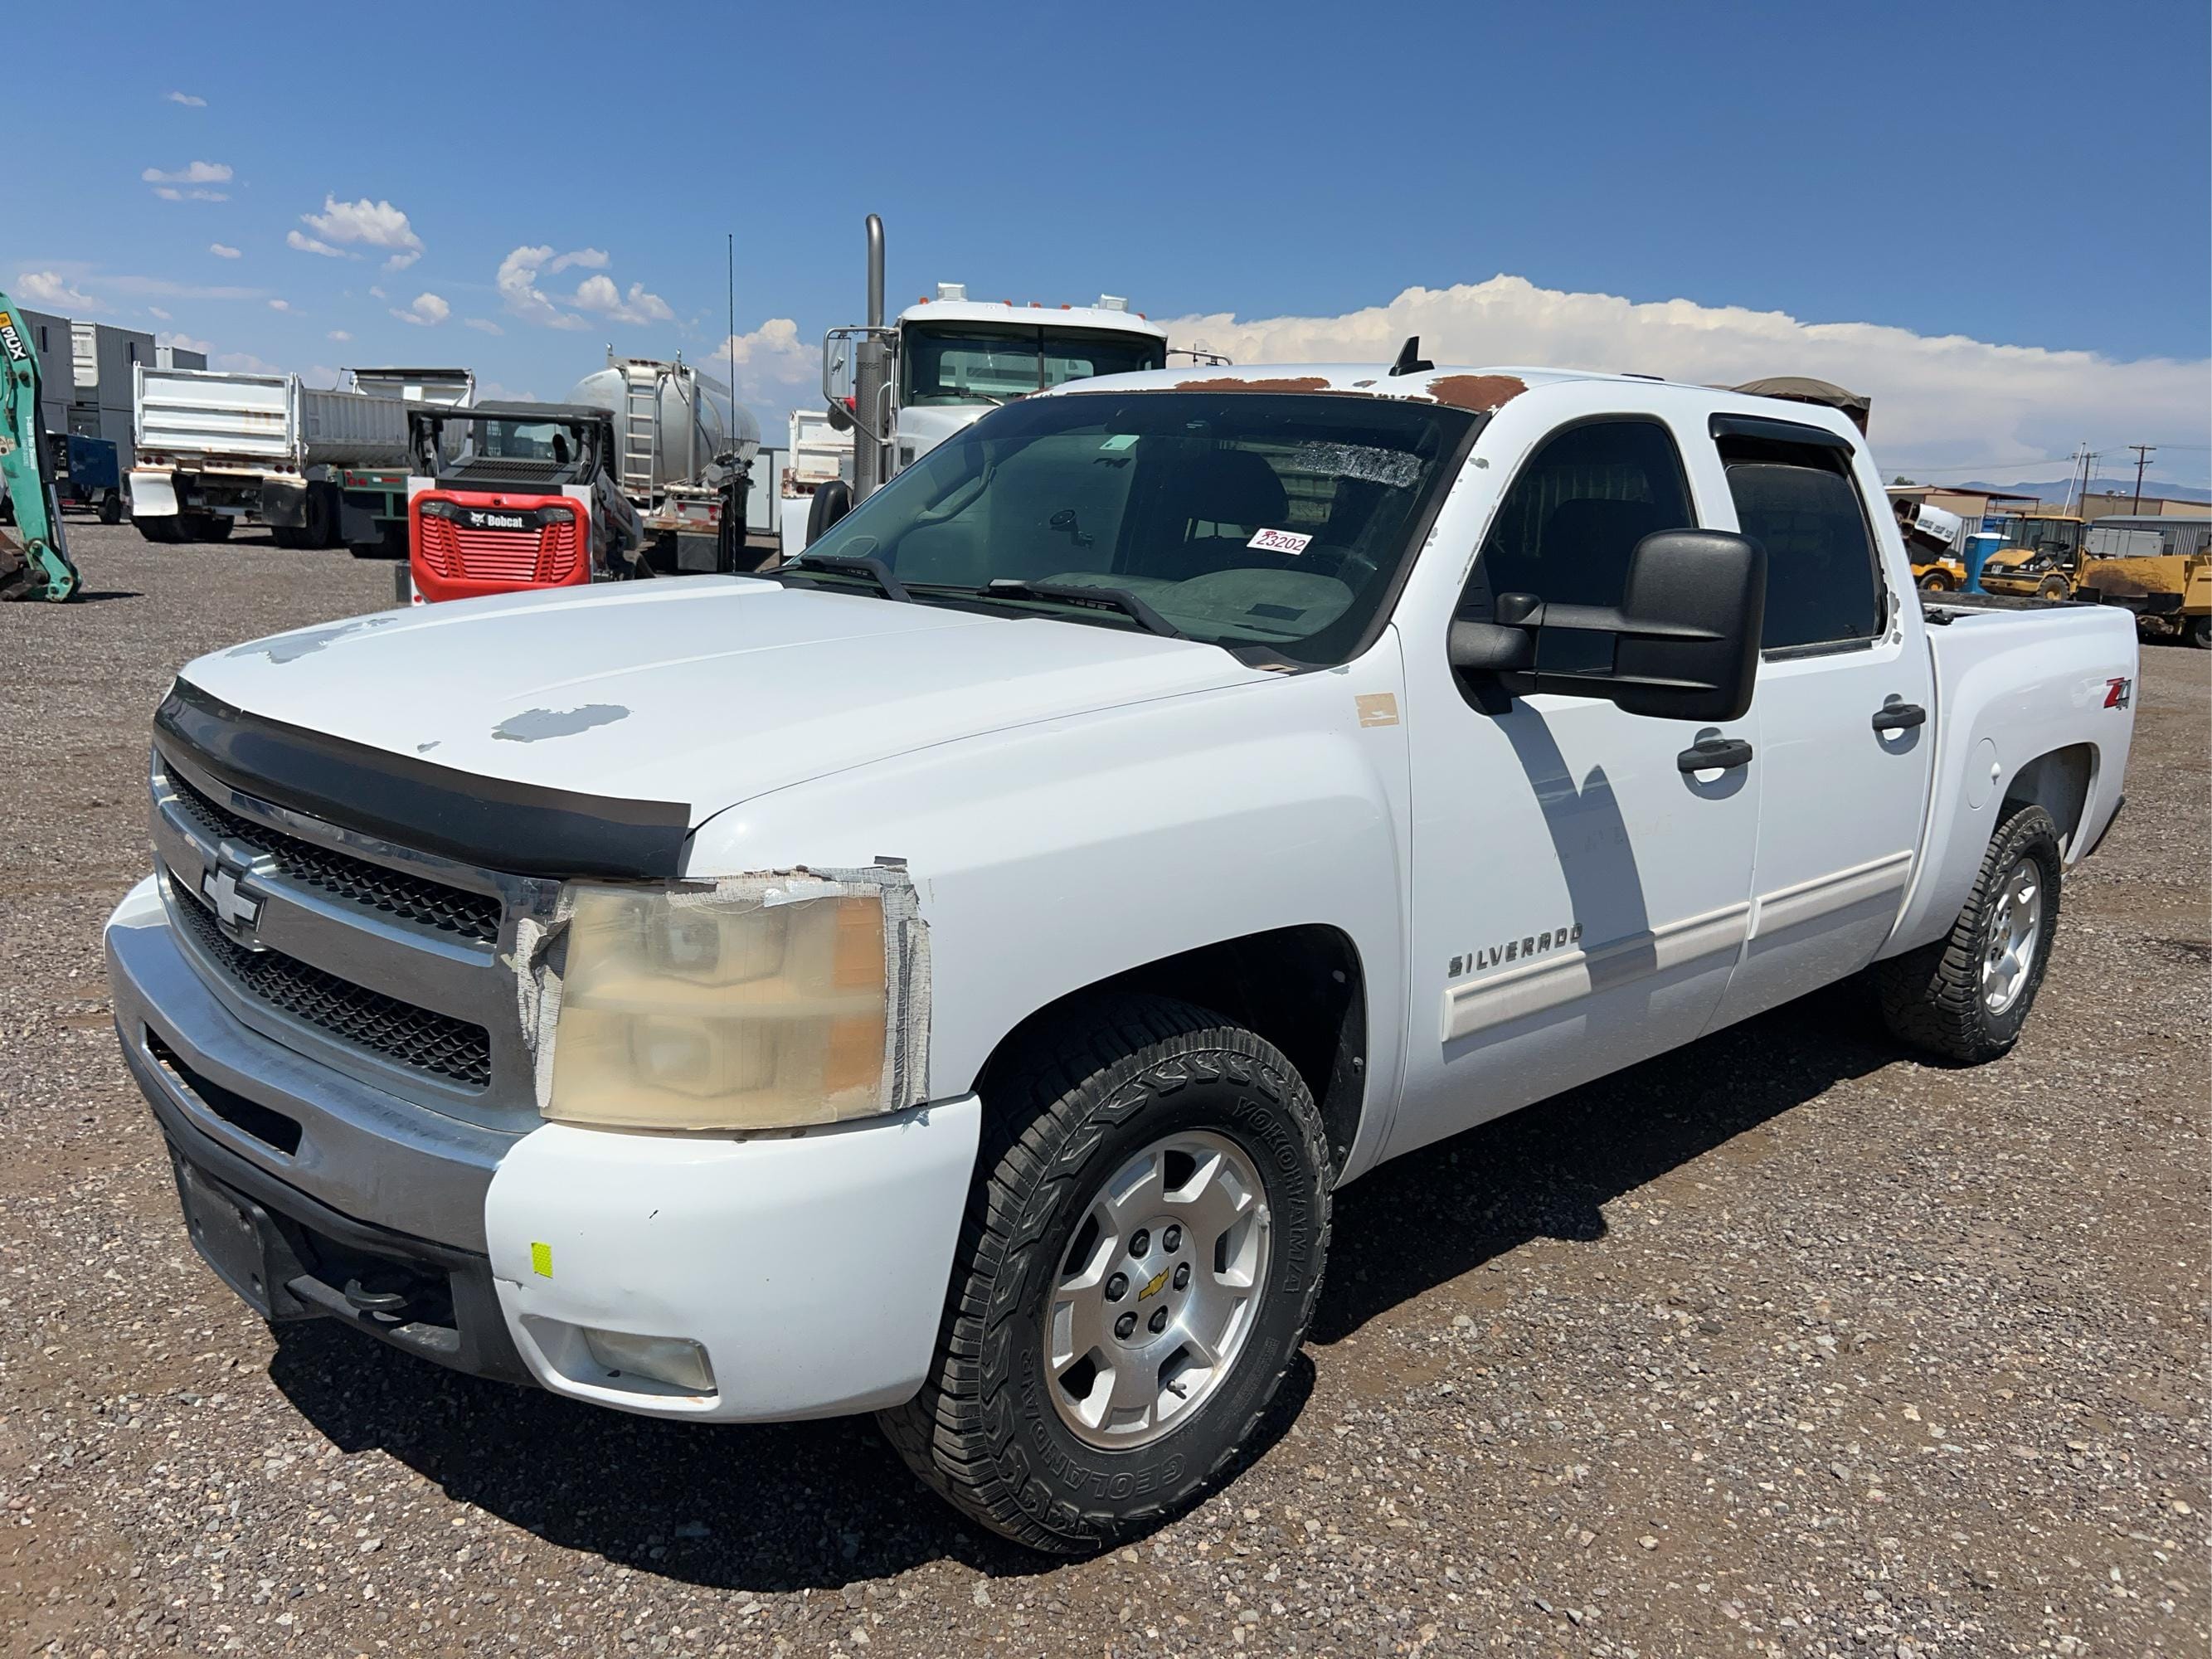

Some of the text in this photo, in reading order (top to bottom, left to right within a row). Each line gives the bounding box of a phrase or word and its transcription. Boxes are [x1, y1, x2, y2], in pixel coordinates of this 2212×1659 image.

[488, 514, 523, 528] Bobcat
[1256, 534, 1306, 552] 23202
[1448, 922, 1583, 979] SILVERADO
[1232, 1096, 1307, 1293] YOKOHAMA
